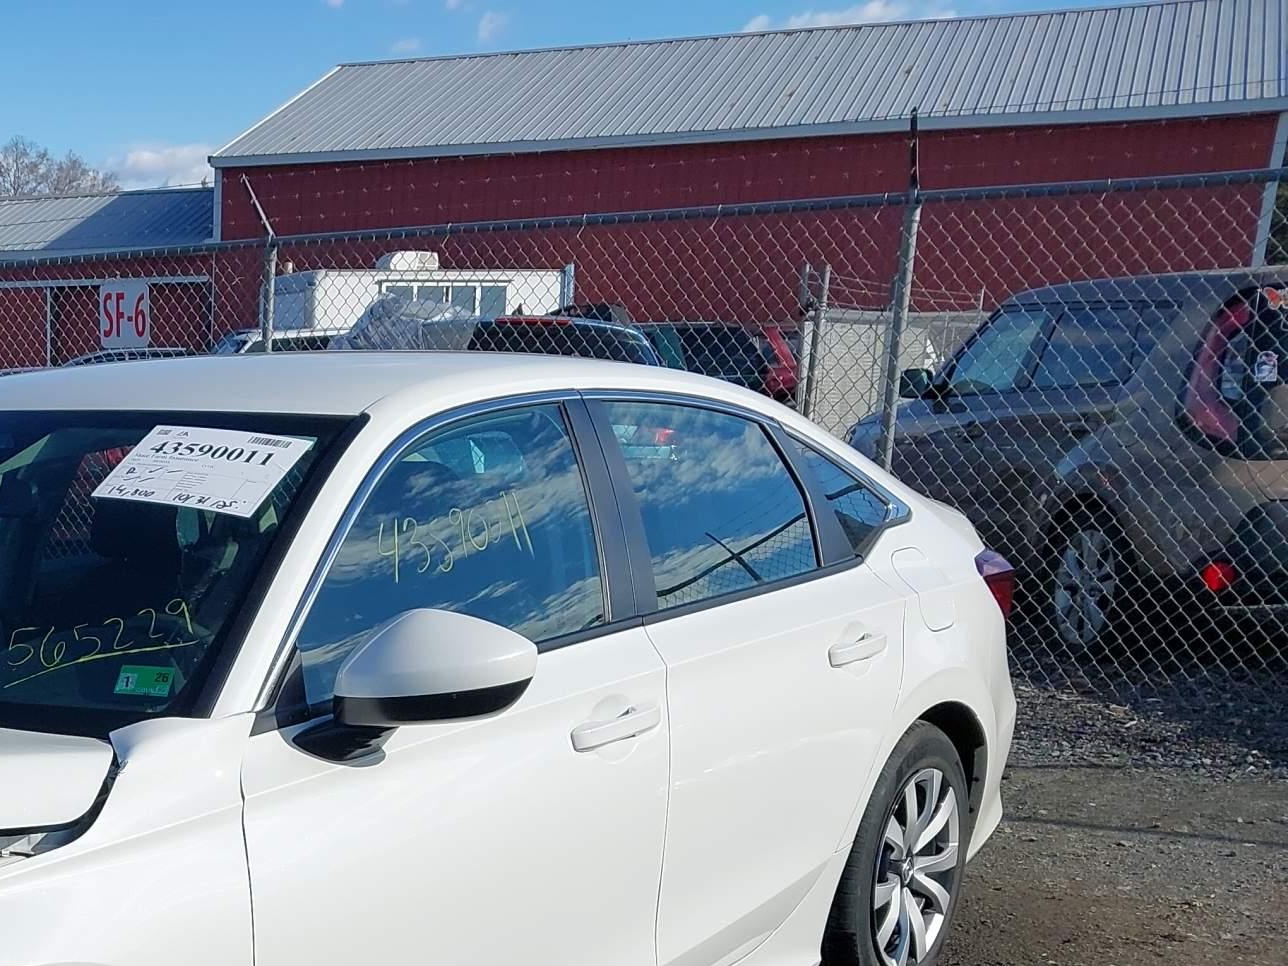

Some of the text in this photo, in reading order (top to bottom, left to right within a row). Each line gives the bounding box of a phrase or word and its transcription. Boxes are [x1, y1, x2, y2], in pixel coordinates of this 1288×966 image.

[103, 292, 146, 338] SF-6
[149, 440, 275, 466] 43590011
[7, 598, 194, 667] 565229
[154, 671, 170, 683] 26
